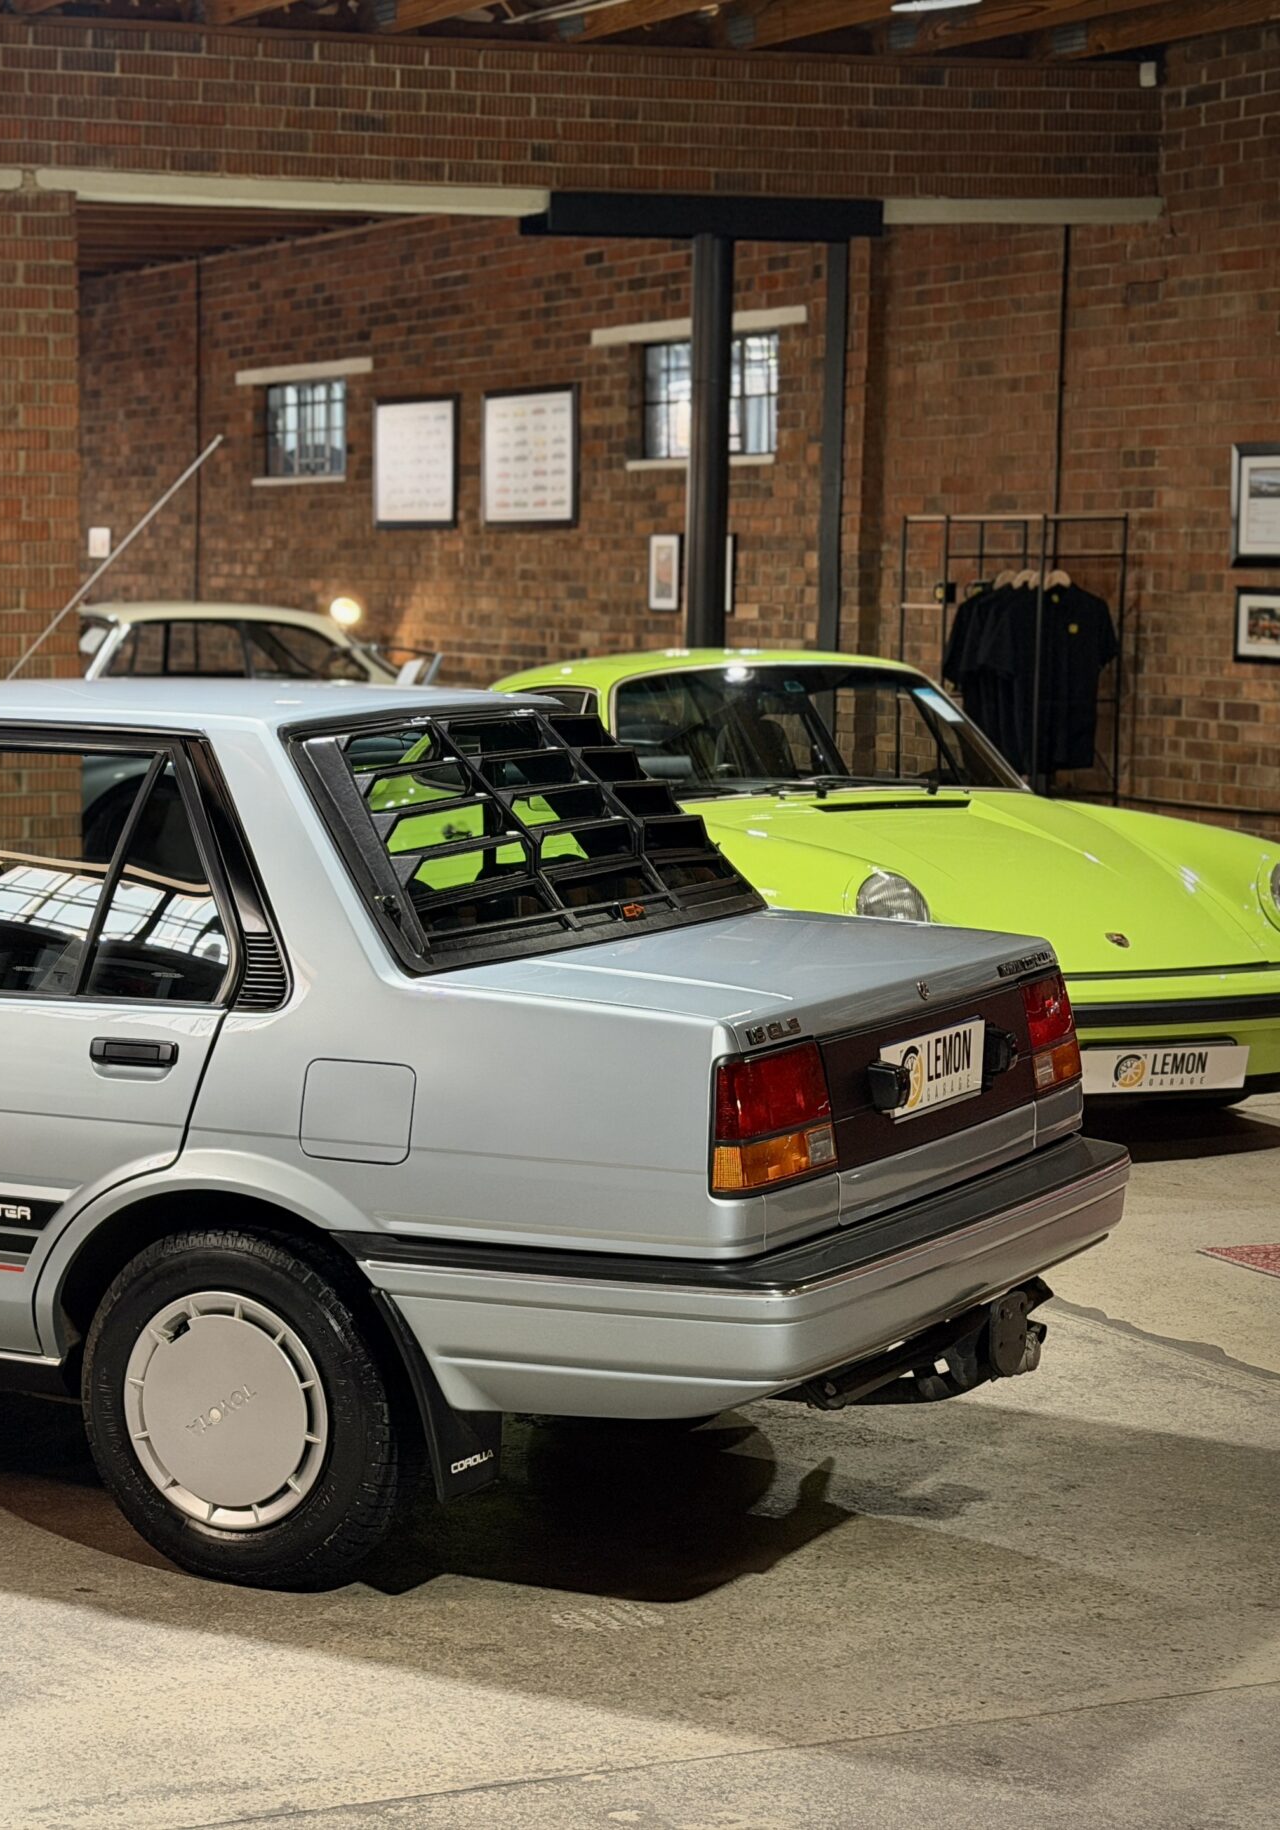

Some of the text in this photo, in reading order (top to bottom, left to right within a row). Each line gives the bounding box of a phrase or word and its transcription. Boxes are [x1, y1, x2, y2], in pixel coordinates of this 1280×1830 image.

[926, 1028, 972, 1083] LEMON
[1151, 1051, 1209, 1076] LEMON
[926, 1073, 971, 1102] GARAGE
[185, 1384, 257, 1434] TOYOTA
[450, 1448, 495, 1474] COROLLA
